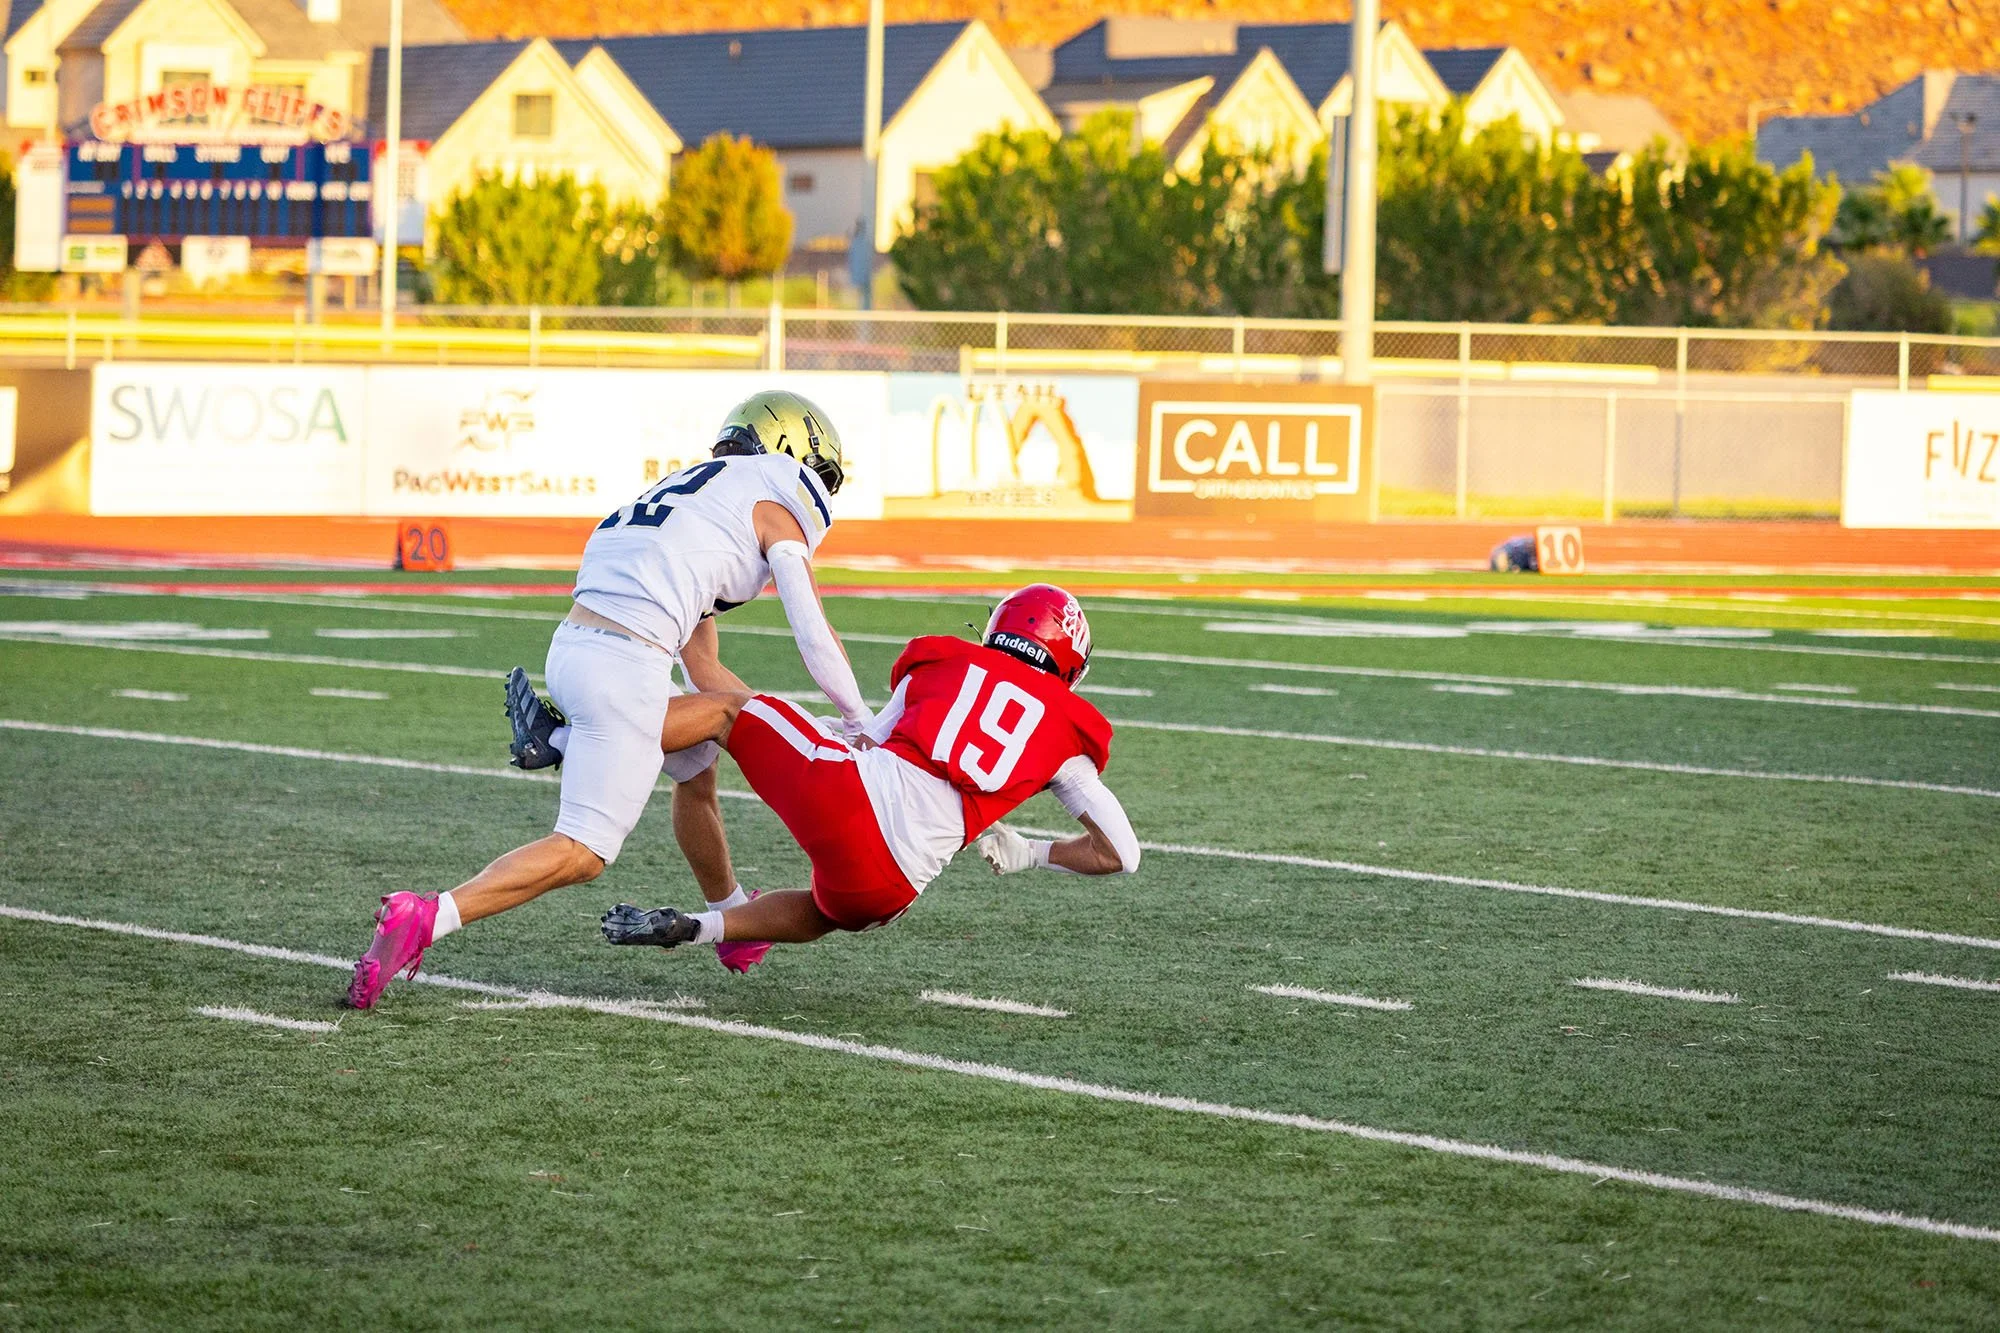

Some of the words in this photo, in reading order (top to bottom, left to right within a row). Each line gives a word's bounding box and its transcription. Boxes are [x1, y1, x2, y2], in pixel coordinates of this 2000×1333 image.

[89, 81, 230, 141] CRIMSON
[242, 84, 348, 142] CLIFFS
[108, 384, 349, 444] SWOSA
[966, 382, 1057, 403] UTAH
[1173, 418, 1339, 476] CALL
[408, 527, 446, 561] 20
[1543, 533, 1580, 569] 10
[994, 633, 1048, 665] Riddell
[931, 662, 1046, 793] 19
